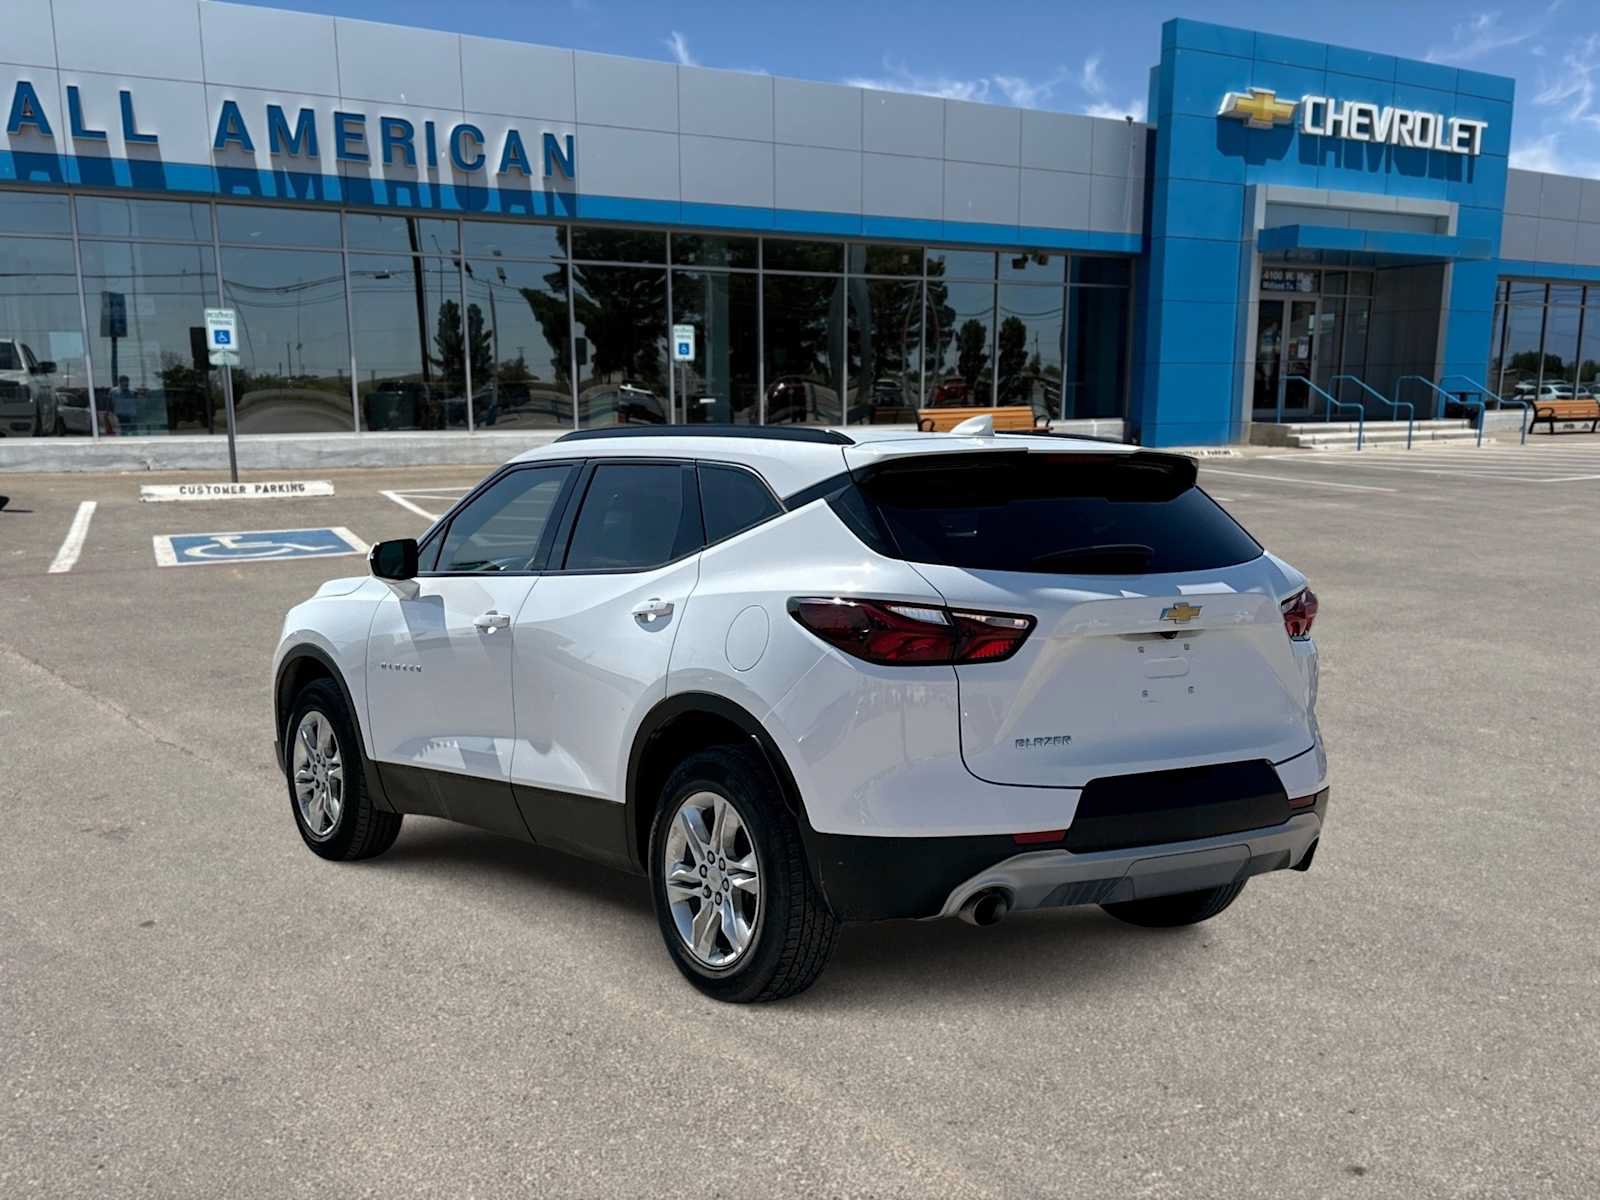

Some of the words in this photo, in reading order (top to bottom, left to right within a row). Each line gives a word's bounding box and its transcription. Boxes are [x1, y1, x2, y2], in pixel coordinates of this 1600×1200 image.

[6, 80, 159, 144] ALL
[212, 100, 576, 178] AMERICAN
[1301, 94, 1489, 156] CHEVROLET
[179, 485, 247, 496] CUSTOMER
[254, 483, 306, 494] PARKING
[1015, 735, 1073, 751] BLAZER
